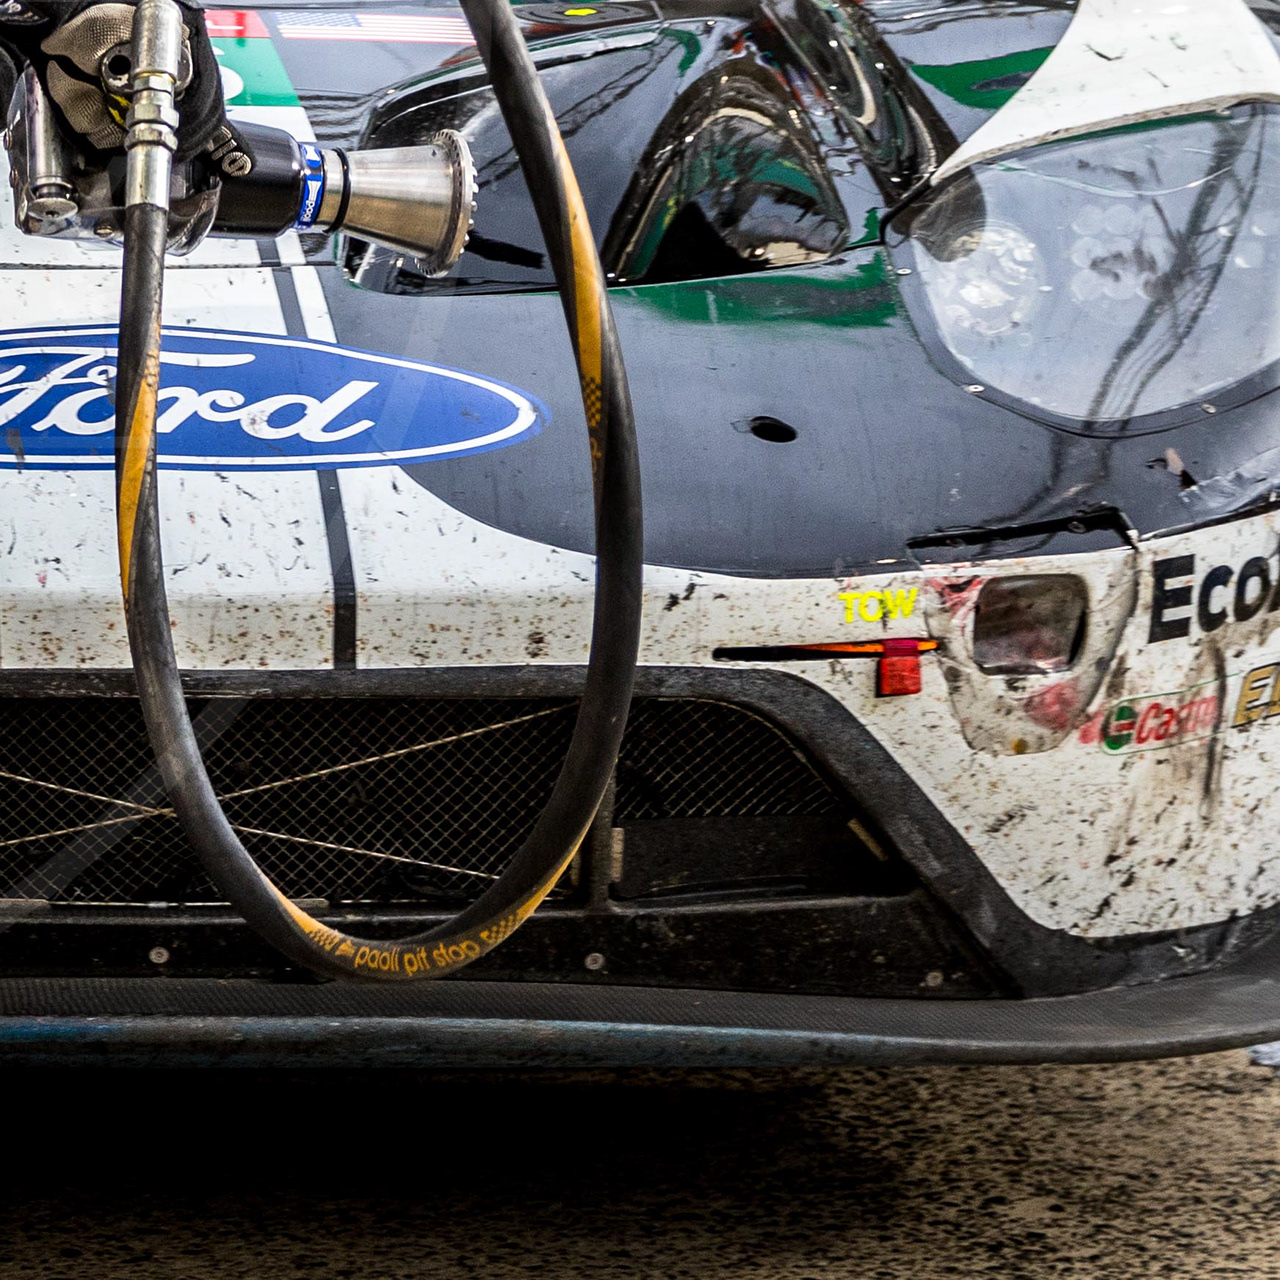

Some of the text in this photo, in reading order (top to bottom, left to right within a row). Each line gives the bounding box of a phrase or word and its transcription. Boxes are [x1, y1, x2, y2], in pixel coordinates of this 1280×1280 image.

[838, 588, 919, 623] TOW
[1149, 554, 1280, 644] Eco
[354, 939, 481, 977] paoli pit stop
